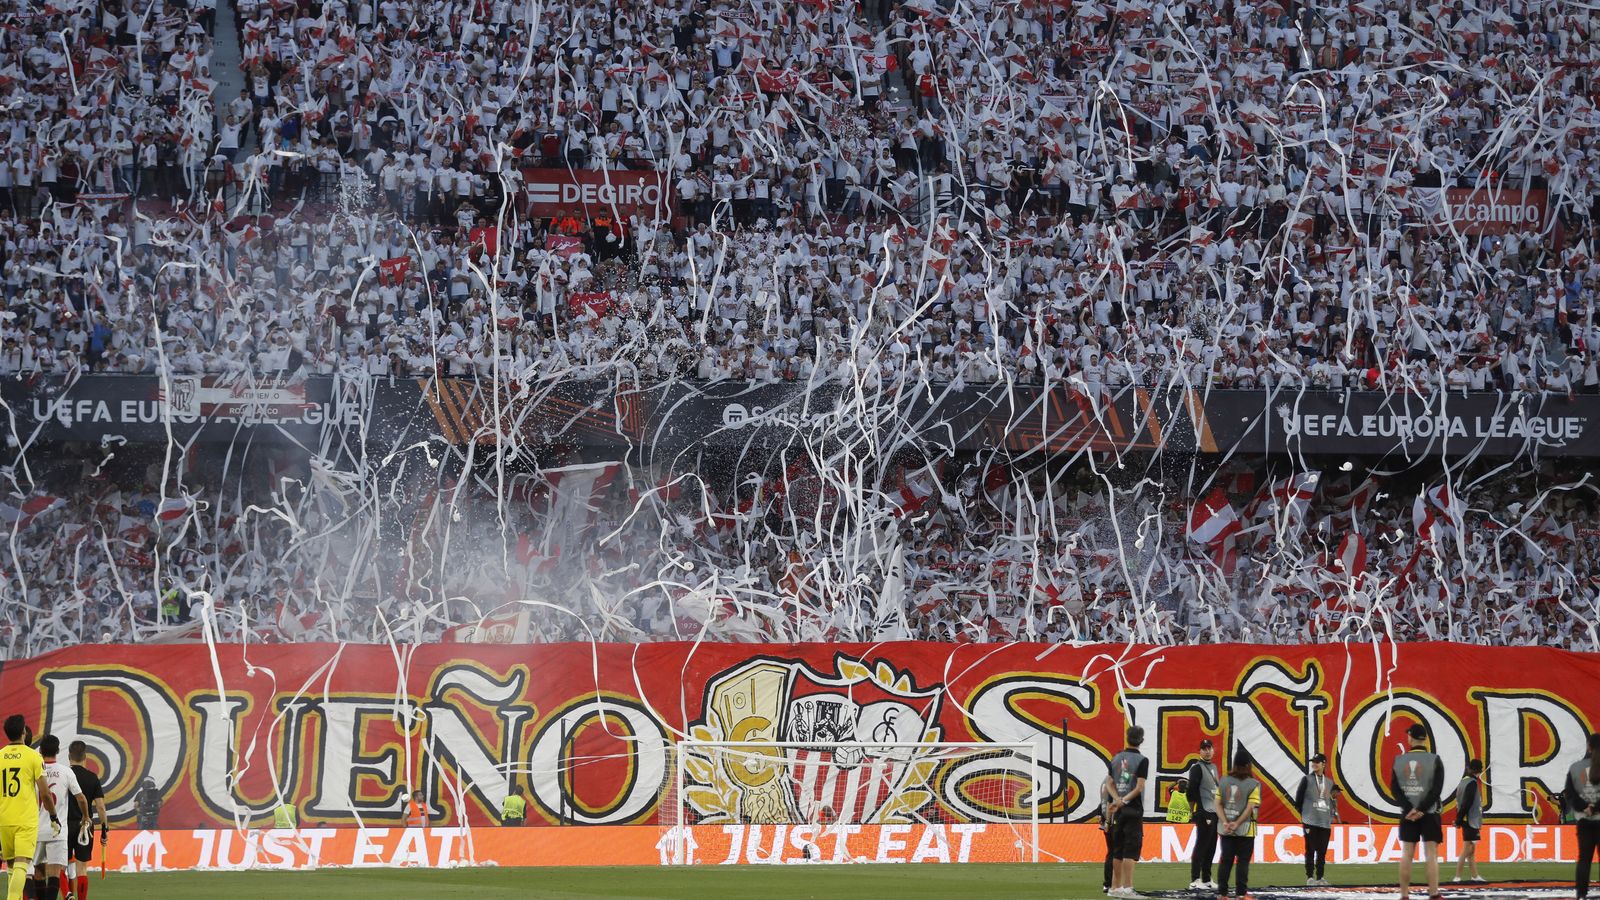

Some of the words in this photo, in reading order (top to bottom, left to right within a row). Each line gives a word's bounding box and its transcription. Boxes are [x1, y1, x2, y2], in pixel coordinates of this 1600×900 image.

[562, 183, 661, 205] DEGIRO
[33, 400, 112, 423] UEFA
[1283, 414, 1354, 437] UEFA
[1362, 416, 1467, 438] EUROPA
[36, 659, 676, 826] DUEÑO
[935, 655, 1598, 826] SEÑOR
[3, 752, 21, 760] BONO
[2, 767, 21, 797] 13
[1169, 808, 1190, 816] ECURITY
[193, 828, 336, 868] JUST
[352, 828, 468, 868] EAT
[719, 824, 861, 864] JUST
[876, 824, 986, 863] EAT
